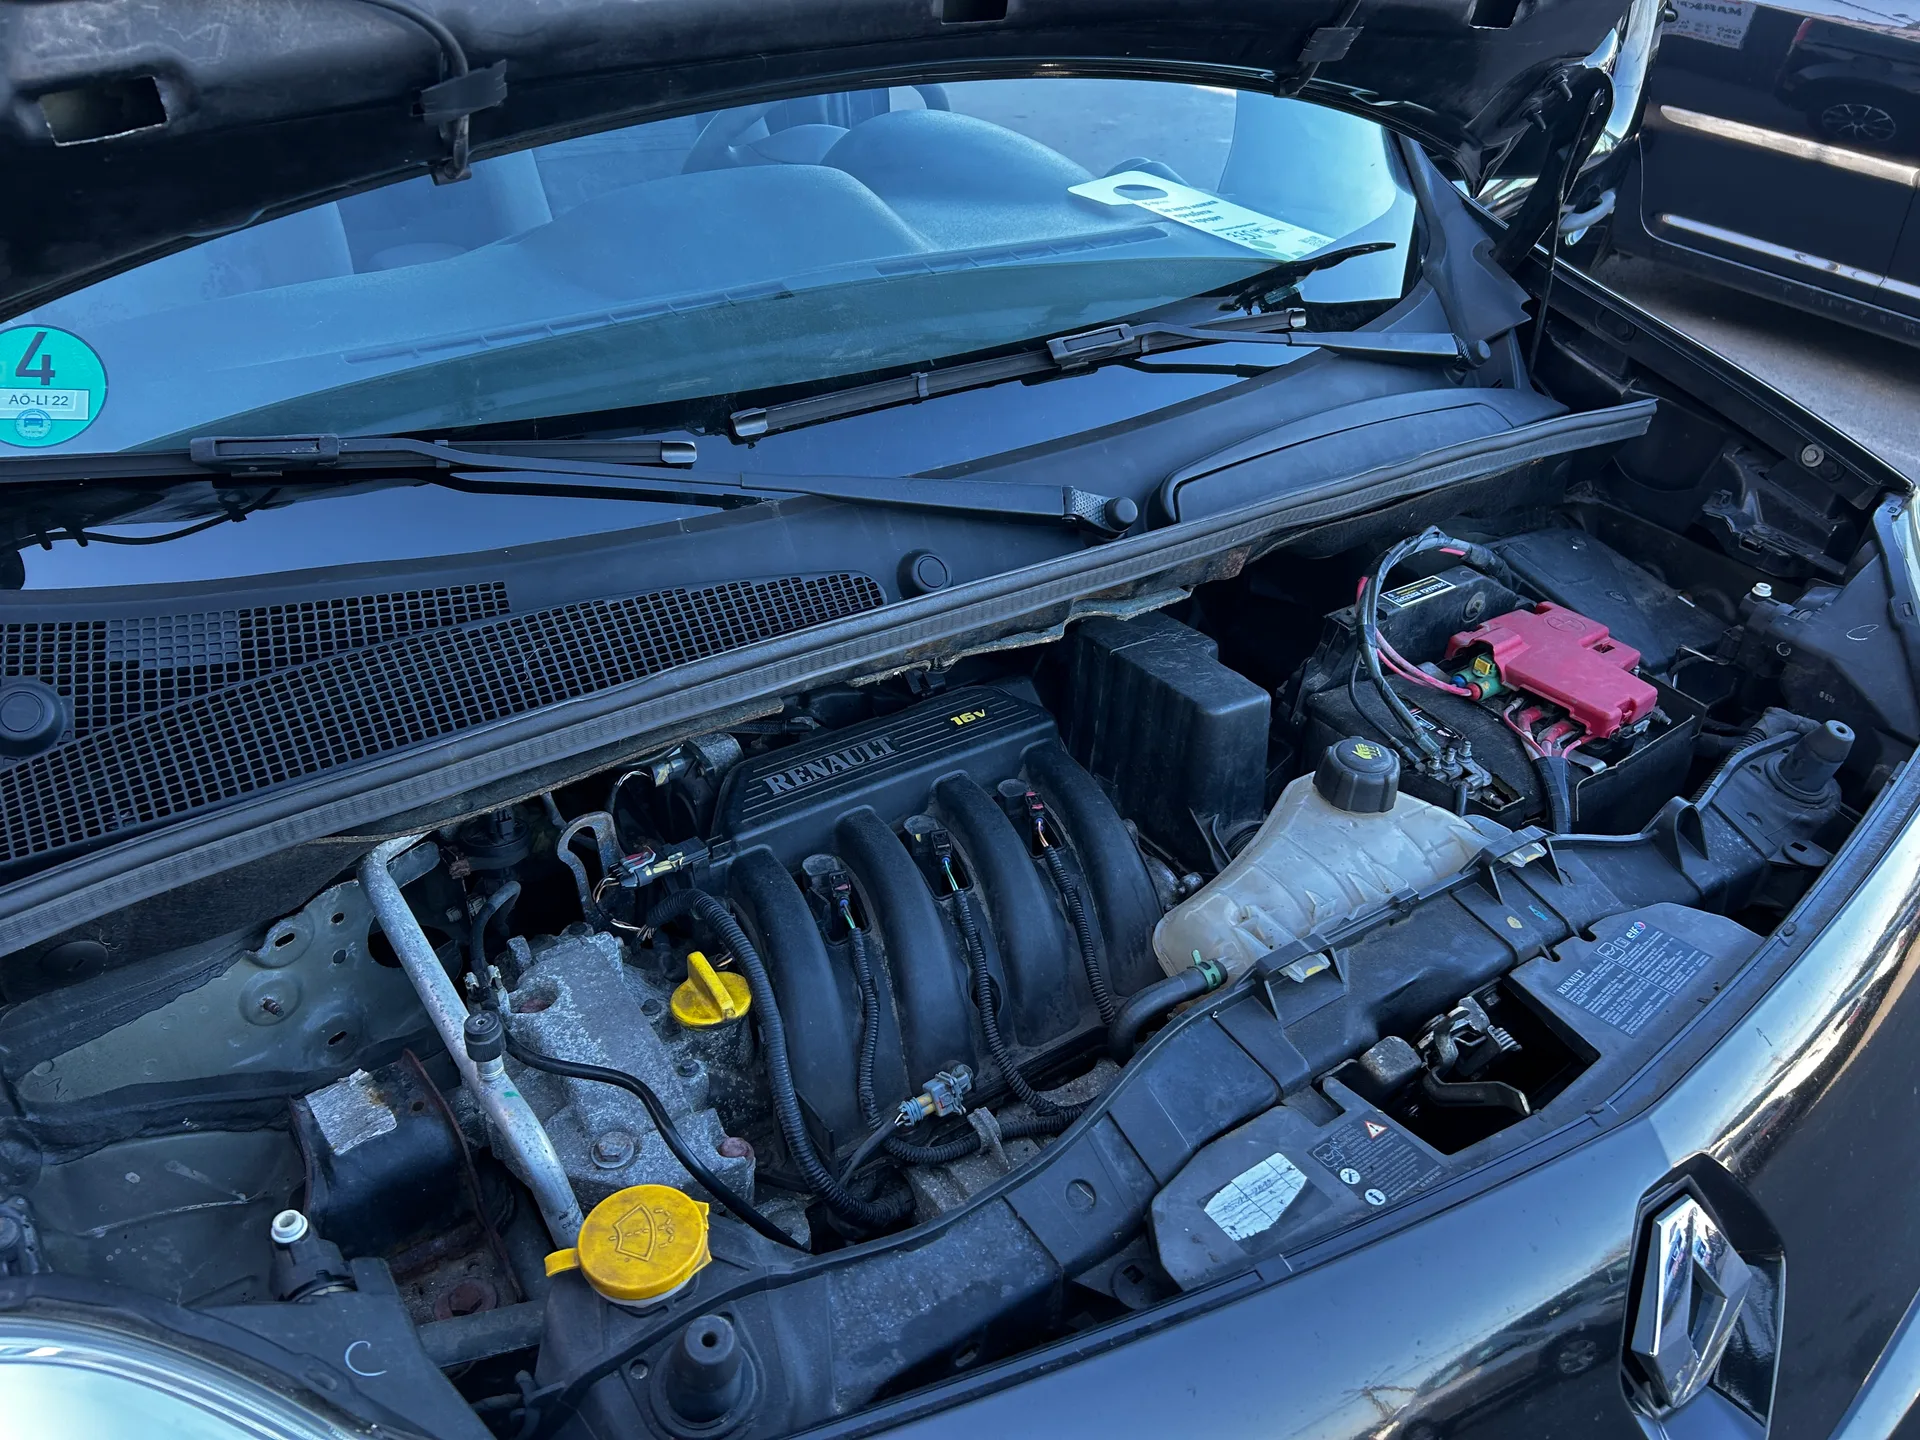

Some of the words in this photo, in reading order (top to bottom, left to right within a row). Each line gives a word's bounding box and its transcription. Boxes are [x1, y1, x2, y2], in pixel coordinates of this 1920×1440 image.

[15, 331, 56, 386] 4
[51, 394, 69, 406] 22
[763, 736, 897, 796] RENAULT
[1556, 969, 1586, 995] RENAULT
